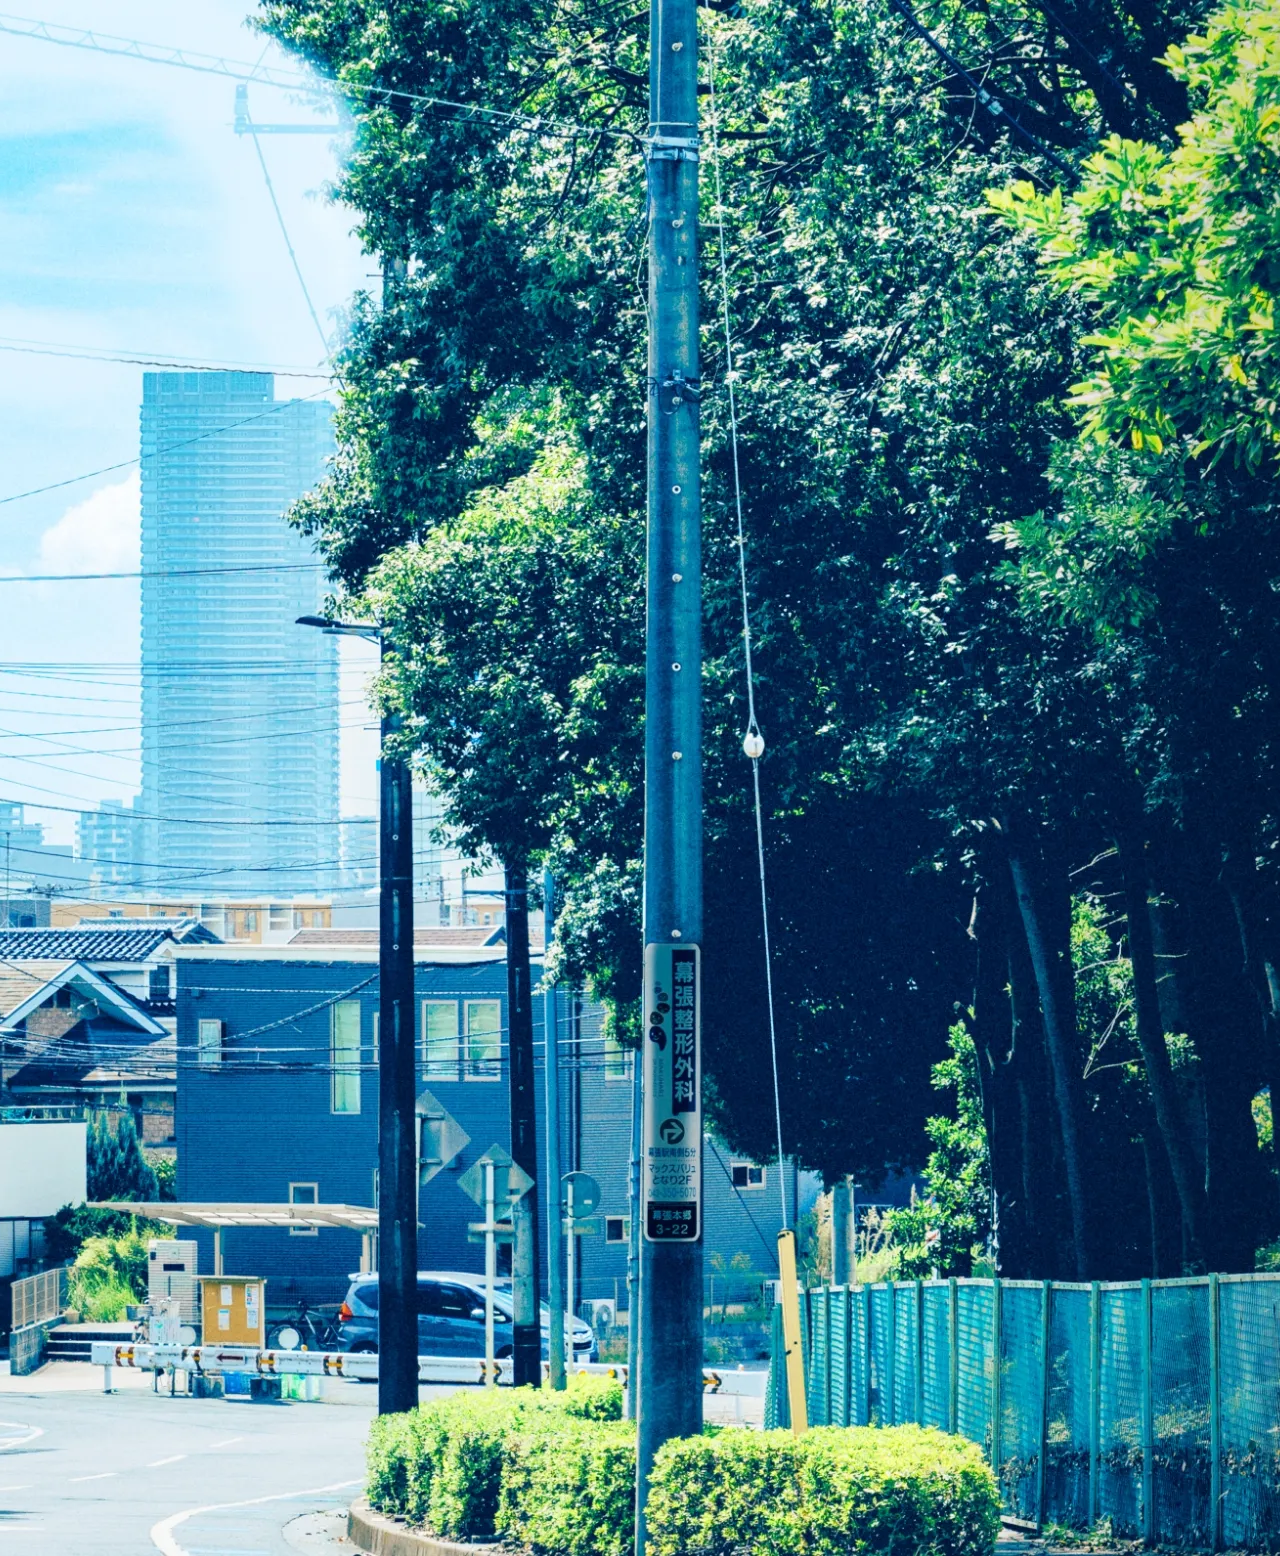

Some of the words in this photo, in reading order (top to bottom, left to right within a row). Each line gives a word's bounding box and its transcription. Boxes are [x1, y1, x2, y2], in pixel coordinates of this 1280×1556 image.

[674, 961, 694, 1102] 幕張整形外科
[648, 1164, 696, 1173] マックスバリュ
[652, 1175, 692, 1185] となり2F
[652, 1210, 692, 1220] 幕張本郷
[656, 1224, 688, 1234] 3-22
